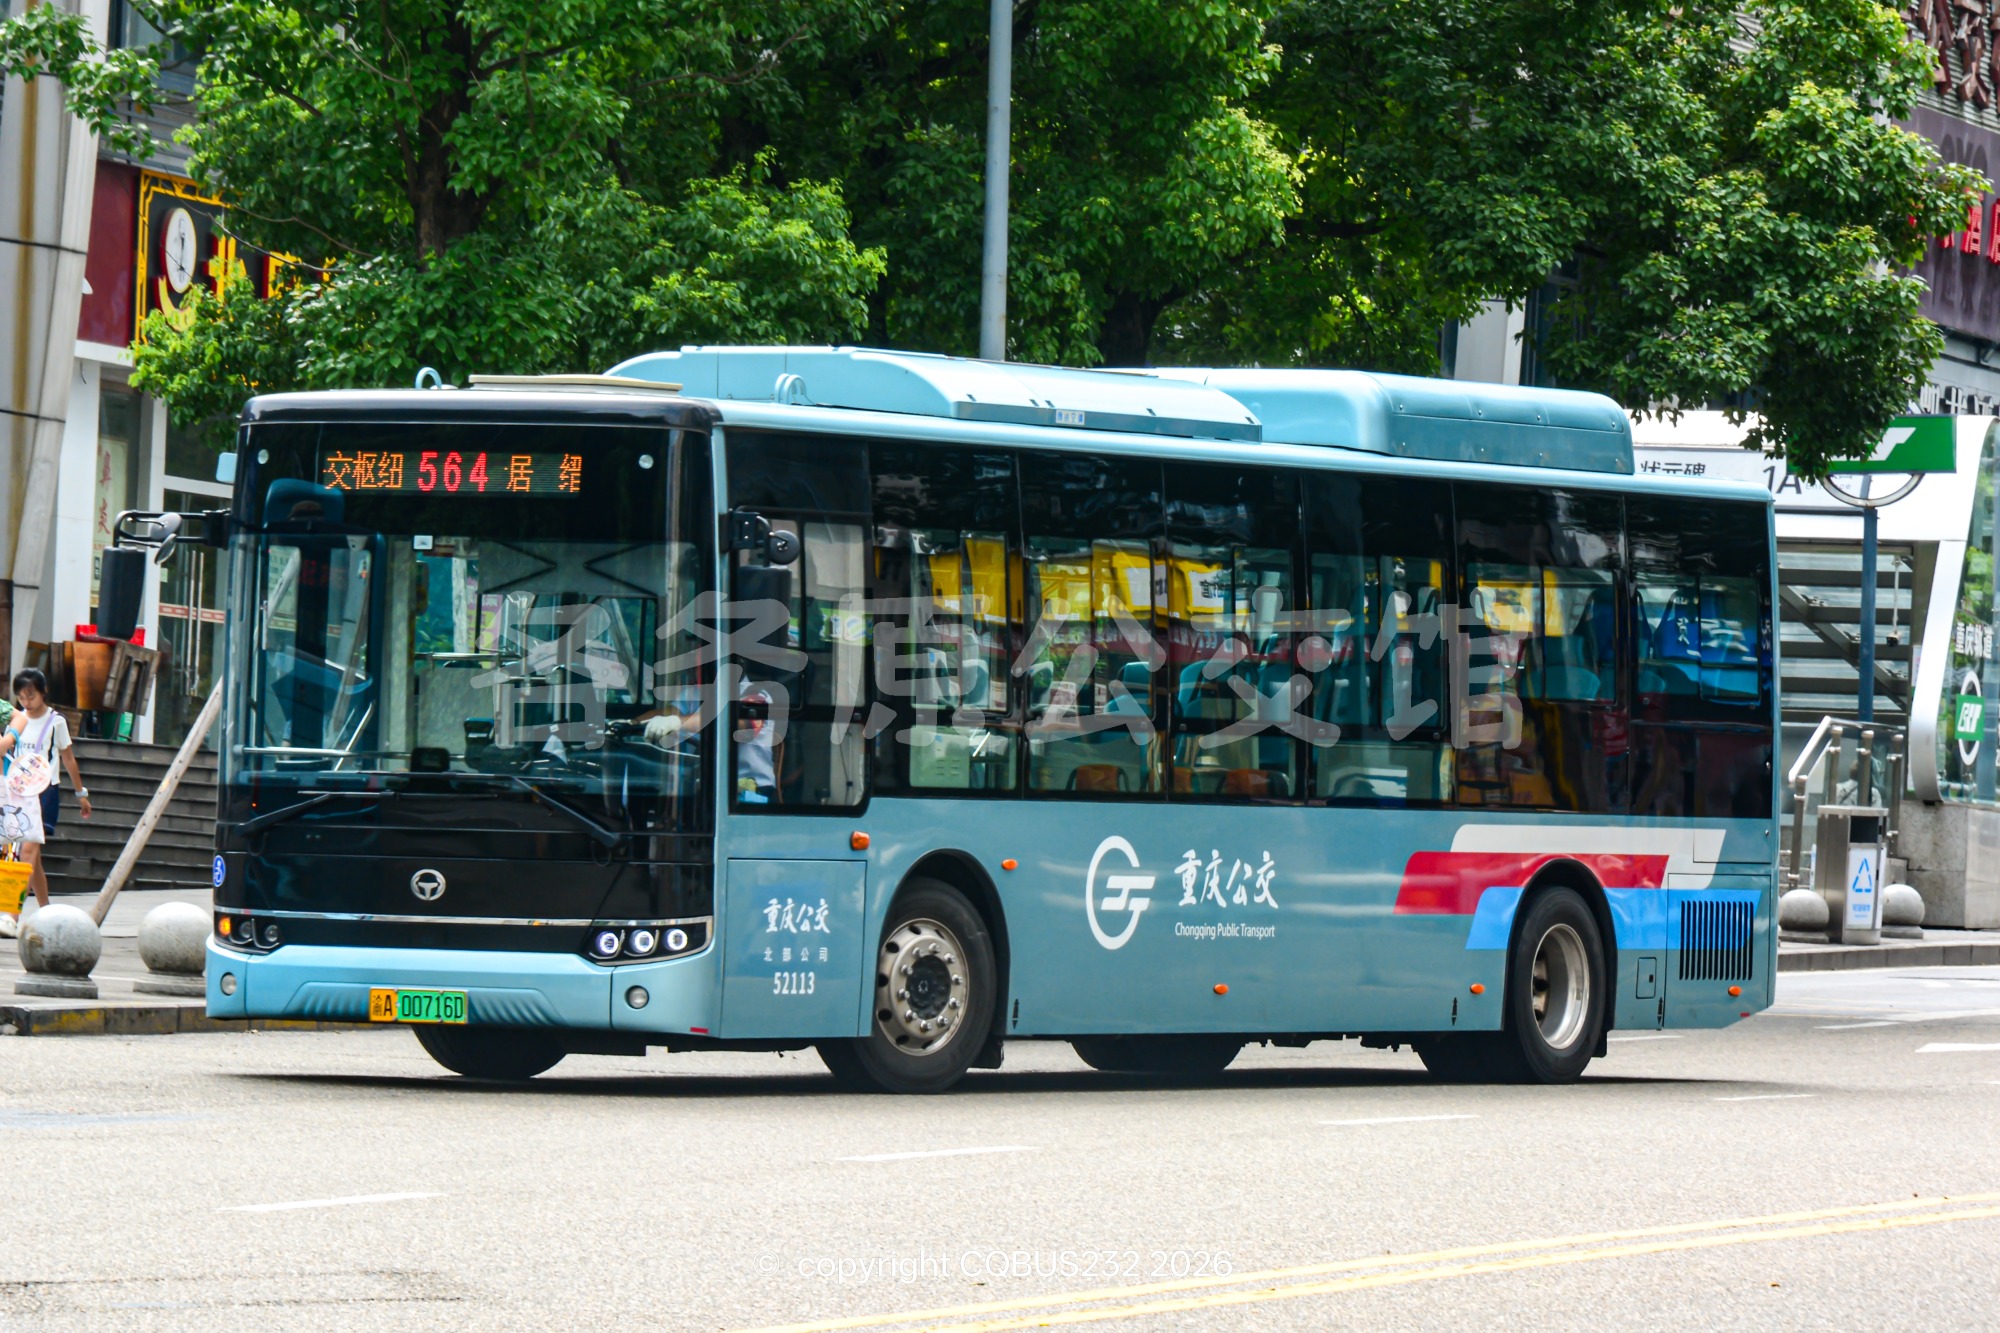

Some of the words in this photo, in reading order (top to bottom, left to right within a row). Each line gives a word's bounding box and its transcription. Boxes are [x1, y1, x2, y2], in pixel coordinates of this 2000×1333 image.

[325, 451, 404, 489] 交枢纽
[417, 451, 489, 492] 564
[507, 455, 534, 492] 居
[1763, 465, 1802, 494] 1A
[1174, 849, 1279, 909] 重庆公交
[763, 898, 830, 934] 重庆公交
[1175, 922, 1216, 940] Chongqing
[1217, 923, 1240, 937] Public
[1240, 923, 1276, 940] Transport
[773, 971, 816, 995] 52113
